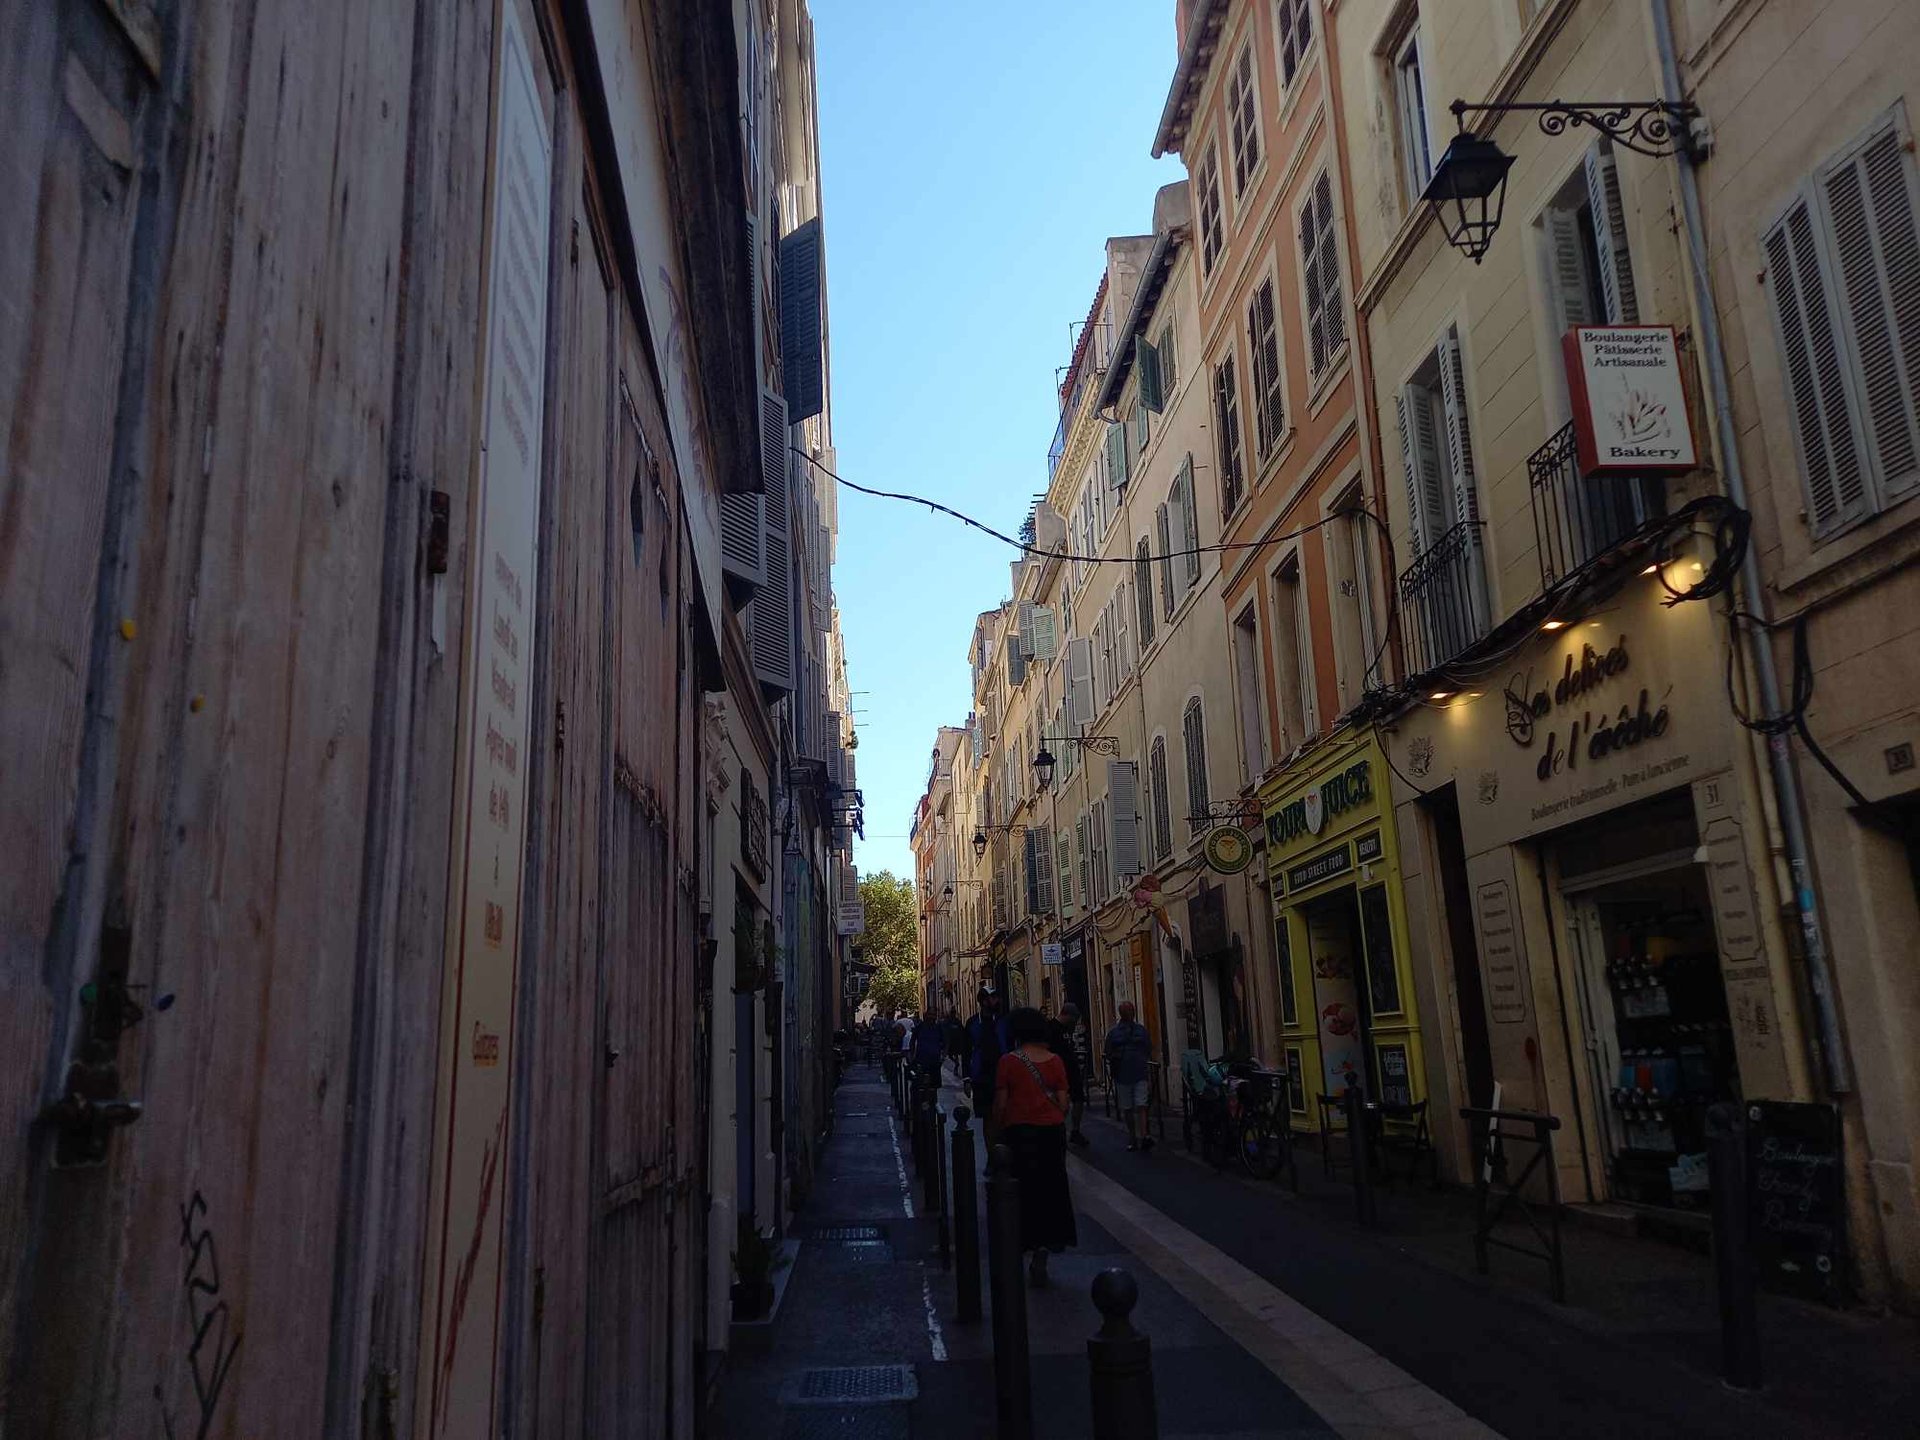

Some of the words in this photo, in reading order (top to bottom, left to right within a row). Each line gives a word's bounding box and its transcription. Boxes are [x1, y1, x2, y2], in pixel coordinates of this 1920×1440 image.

[1584, 332, 1669, 344] Boulangerie
[1594, 343, 1663, 356] Pâtisserie
[1594, 356, 1668, 368] Artisanale
[1610, 446, 1681, 460] Bakery
[1537, 732, 1565, 781] de
[1320, 760, 1370, 825] JUICE
